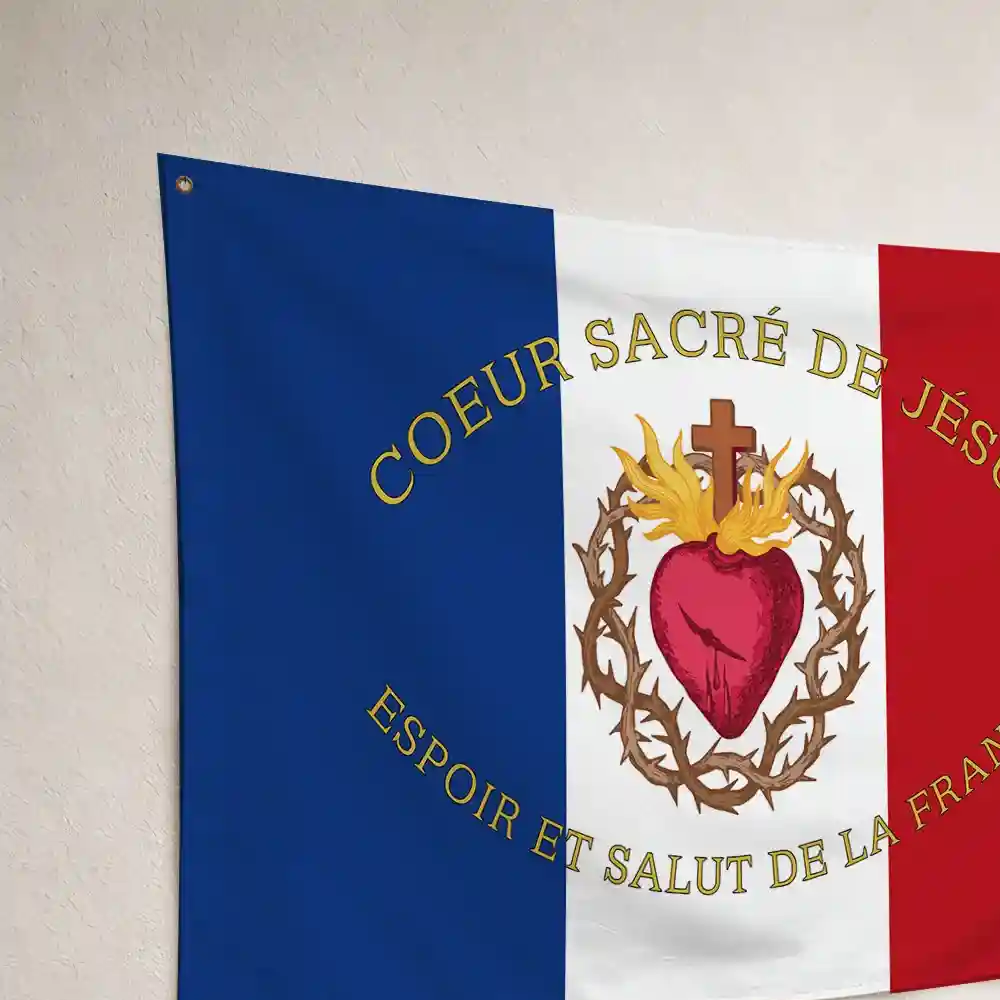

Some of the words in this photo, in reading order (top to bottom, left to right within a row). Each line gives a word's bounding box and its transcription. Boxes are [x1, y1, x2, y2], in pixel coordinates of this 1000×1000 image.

[370, 335, 574, 505] COEUR
[584, 306, 789, 371] SACRÉ
[806, 329, 889, 400] DE
[366, 684, 521, 841] ESPOIR
[529, 816, 594, 874] ET
[603, 845, 753, 896] SALUT
[768, 839, 829, 890] DE
[839, 814, 901, 869] LA
